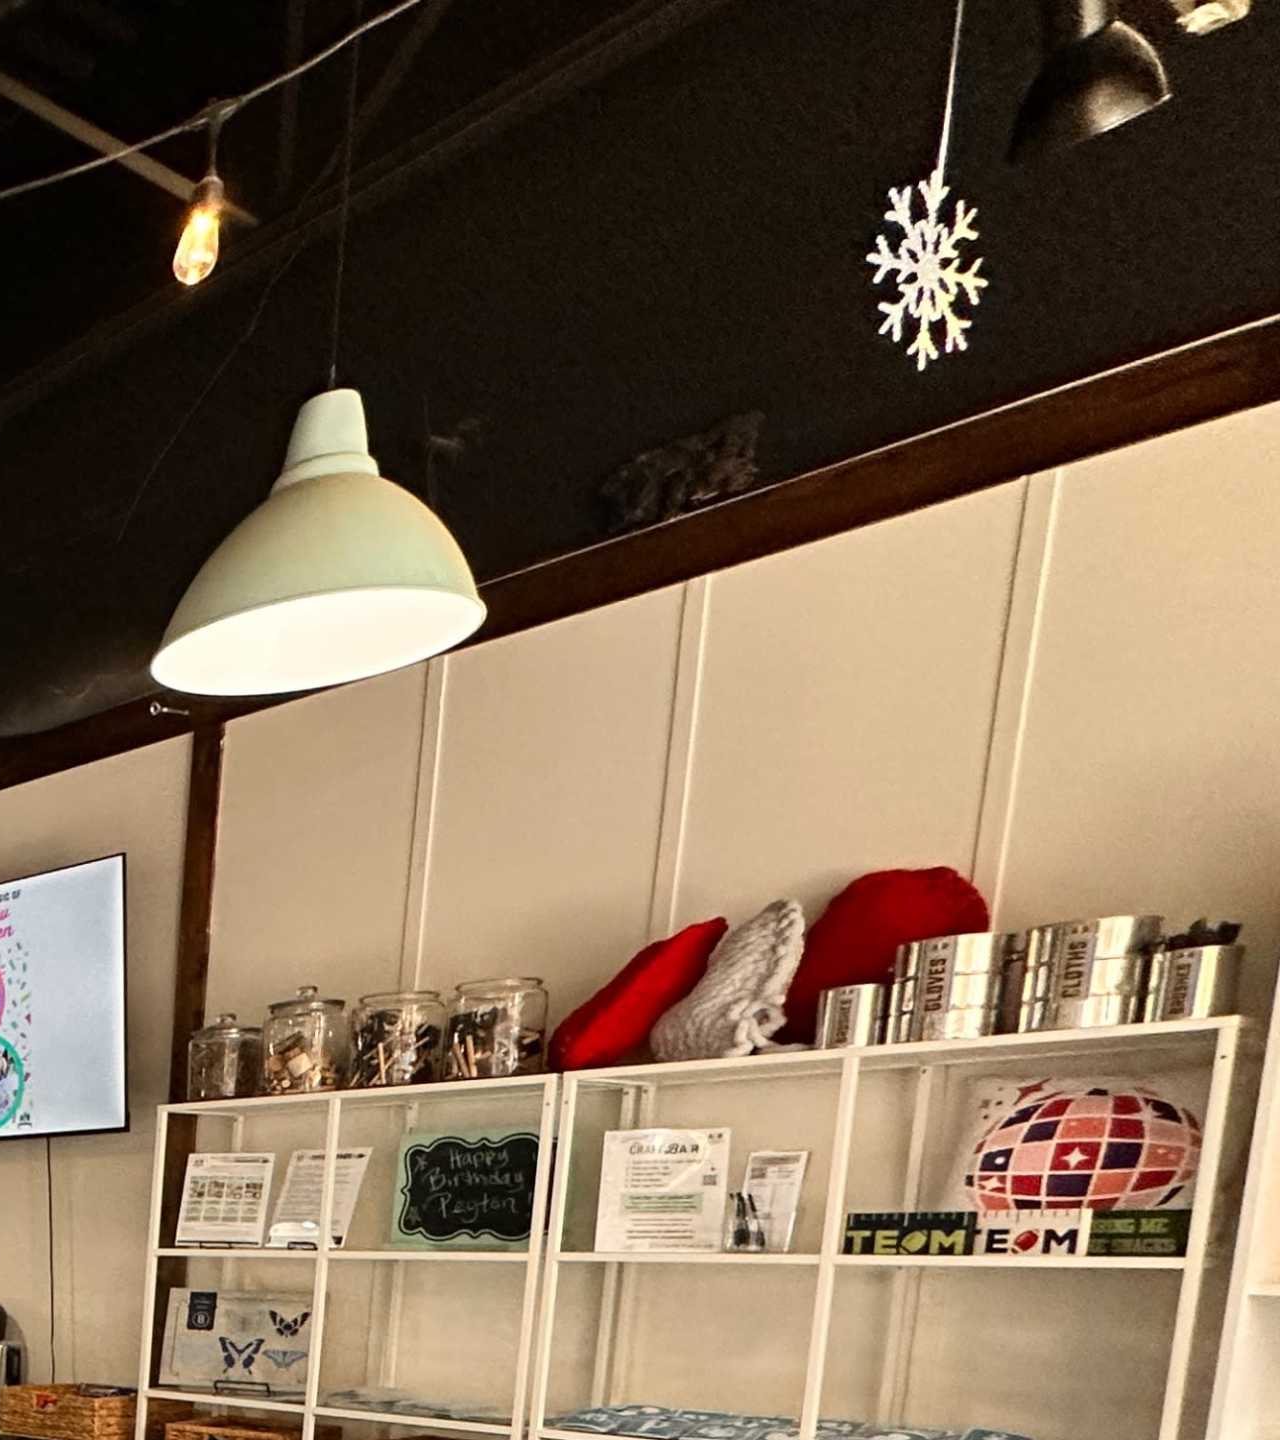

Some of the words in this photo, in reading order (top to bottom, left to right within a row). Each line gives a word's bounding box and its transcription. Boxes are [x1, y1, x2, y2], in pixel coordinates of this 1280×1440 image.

[11, 889, 22, 900] OF
[924, 958, 947, 1012] GLOVES
[1061, 941, 1087, 998] CLOTHS
[1168, 963, 1192, 1014] BRUSHES
[450, 1148, 509, 1170] Happy
